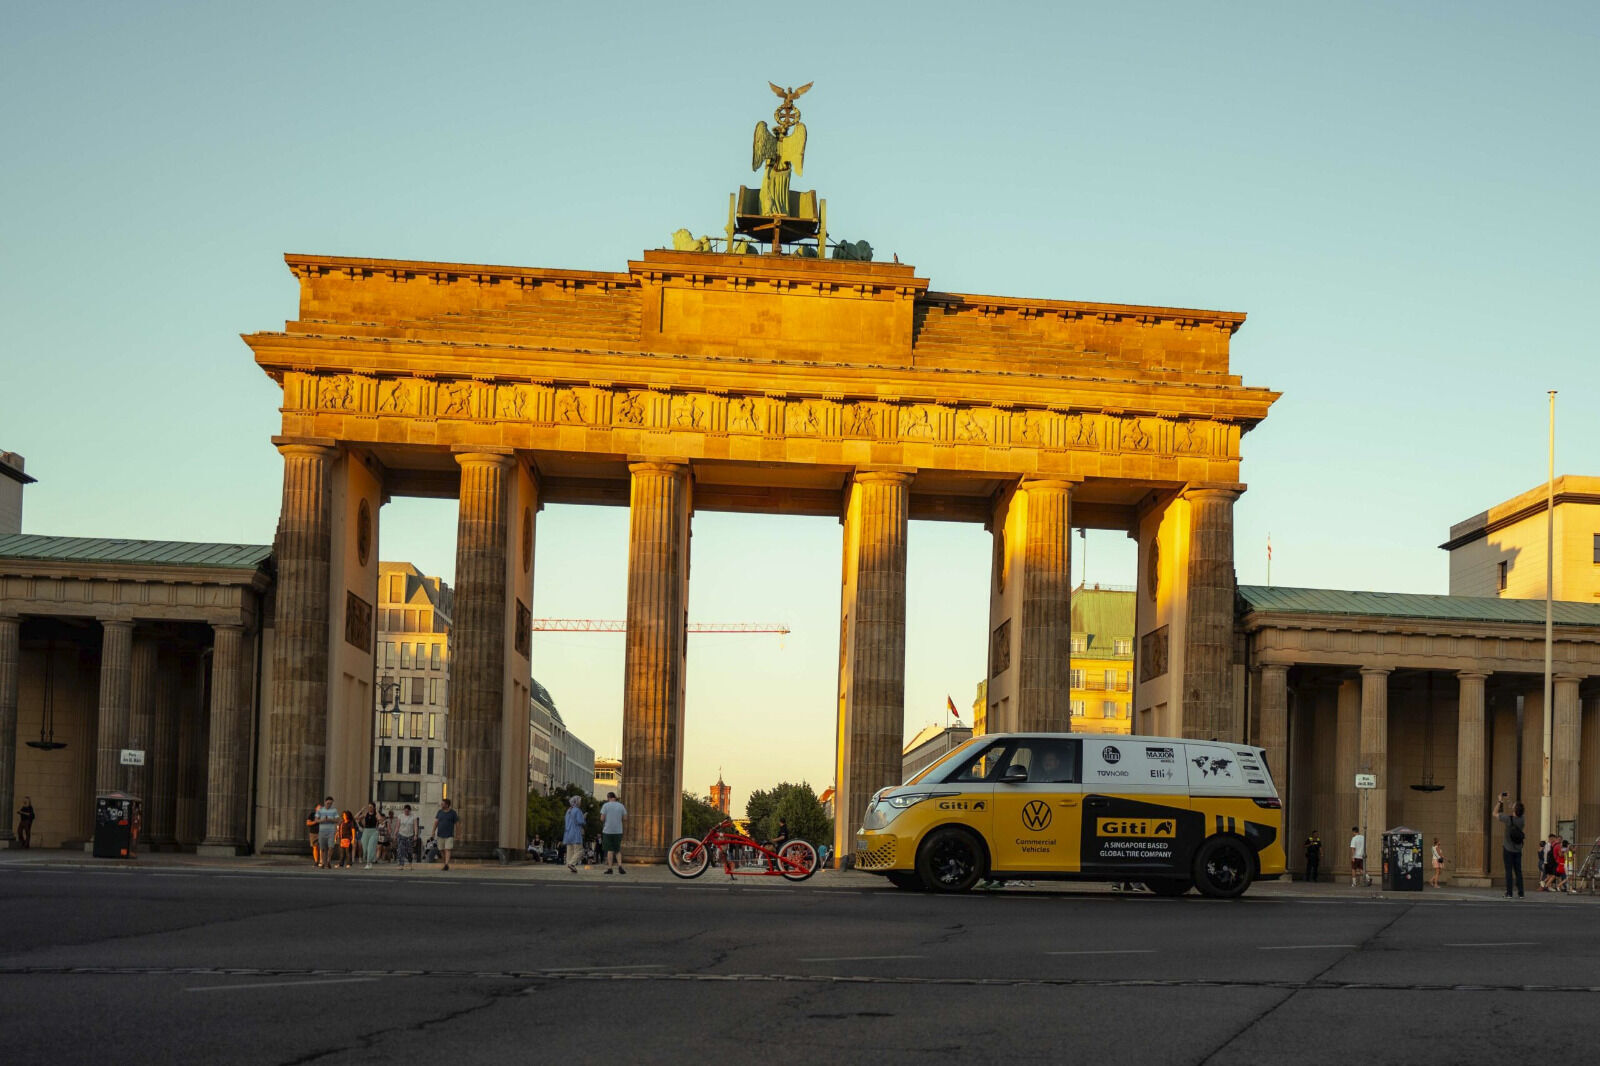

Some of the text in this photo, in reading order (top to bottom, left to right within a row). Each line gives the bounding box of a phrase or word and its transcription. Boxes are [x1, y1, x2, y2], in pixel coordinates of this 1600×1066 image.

[1146, 751, 1174, 759] MAXION
[1150, 769, 1165, 778] Elli
[939, 801, 968, 810] Giti
[1102, 821, 1146, 834] Giti
